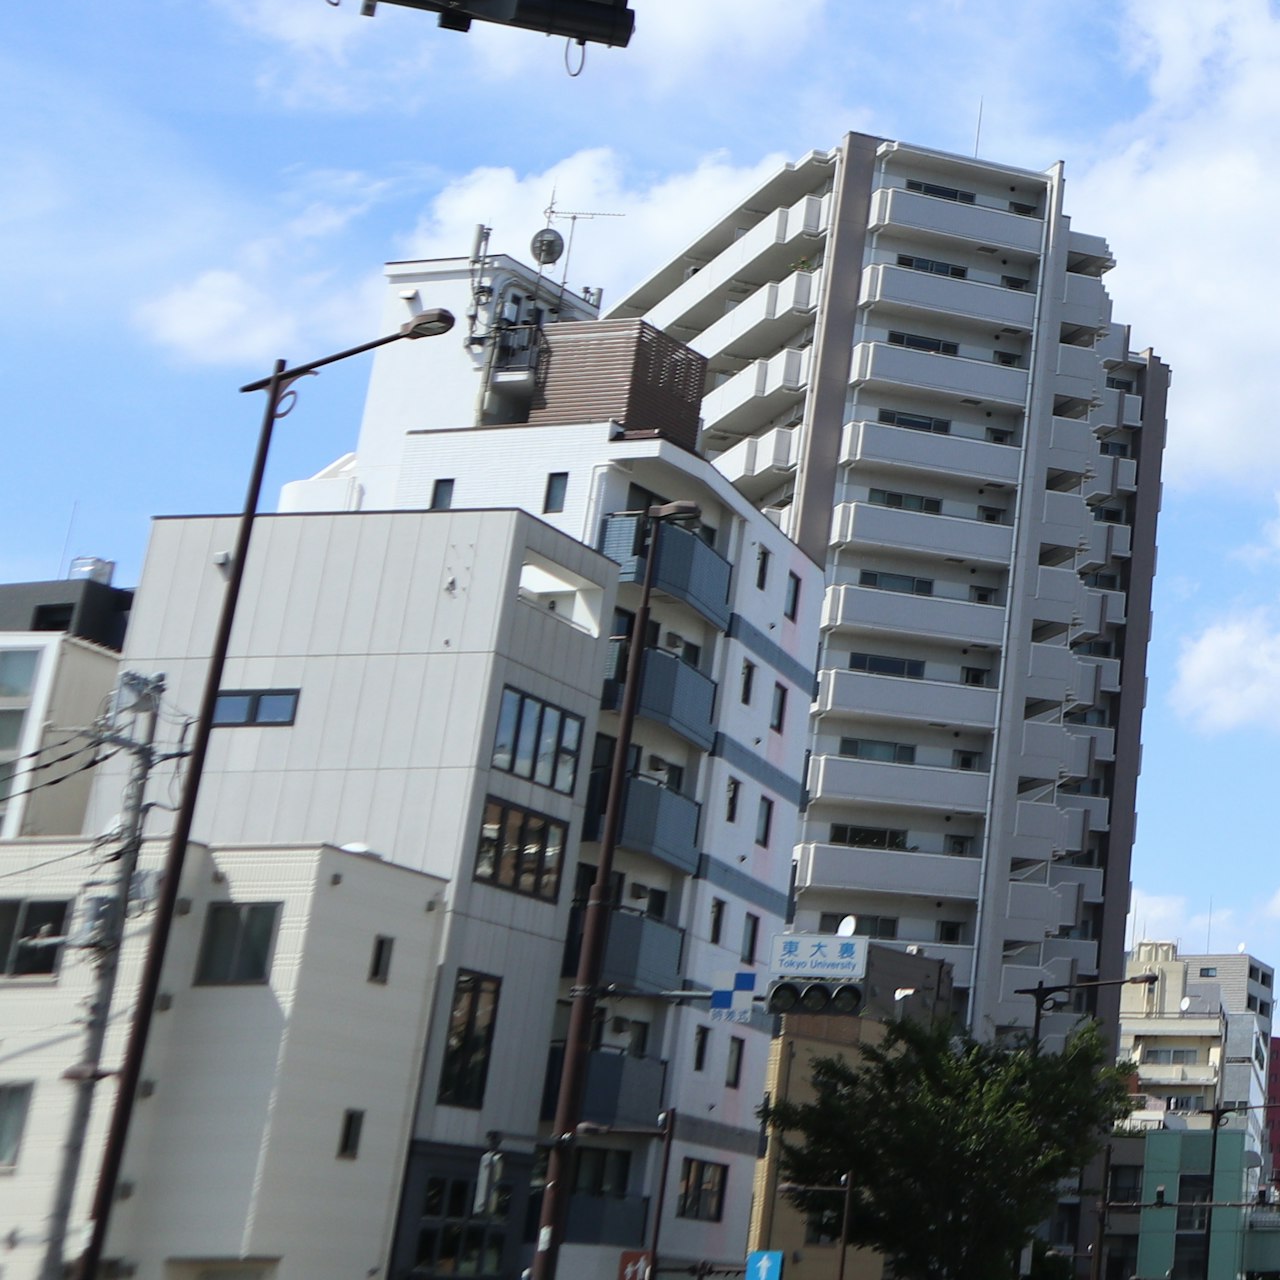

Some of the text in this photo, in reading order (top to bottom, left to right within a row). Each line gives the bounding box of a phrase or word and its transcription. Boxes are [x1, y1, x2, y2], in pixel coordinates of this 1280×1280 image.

[780, 940, 857, 959] 東大裏
[779, 958, 857, 972] Tokyo University
